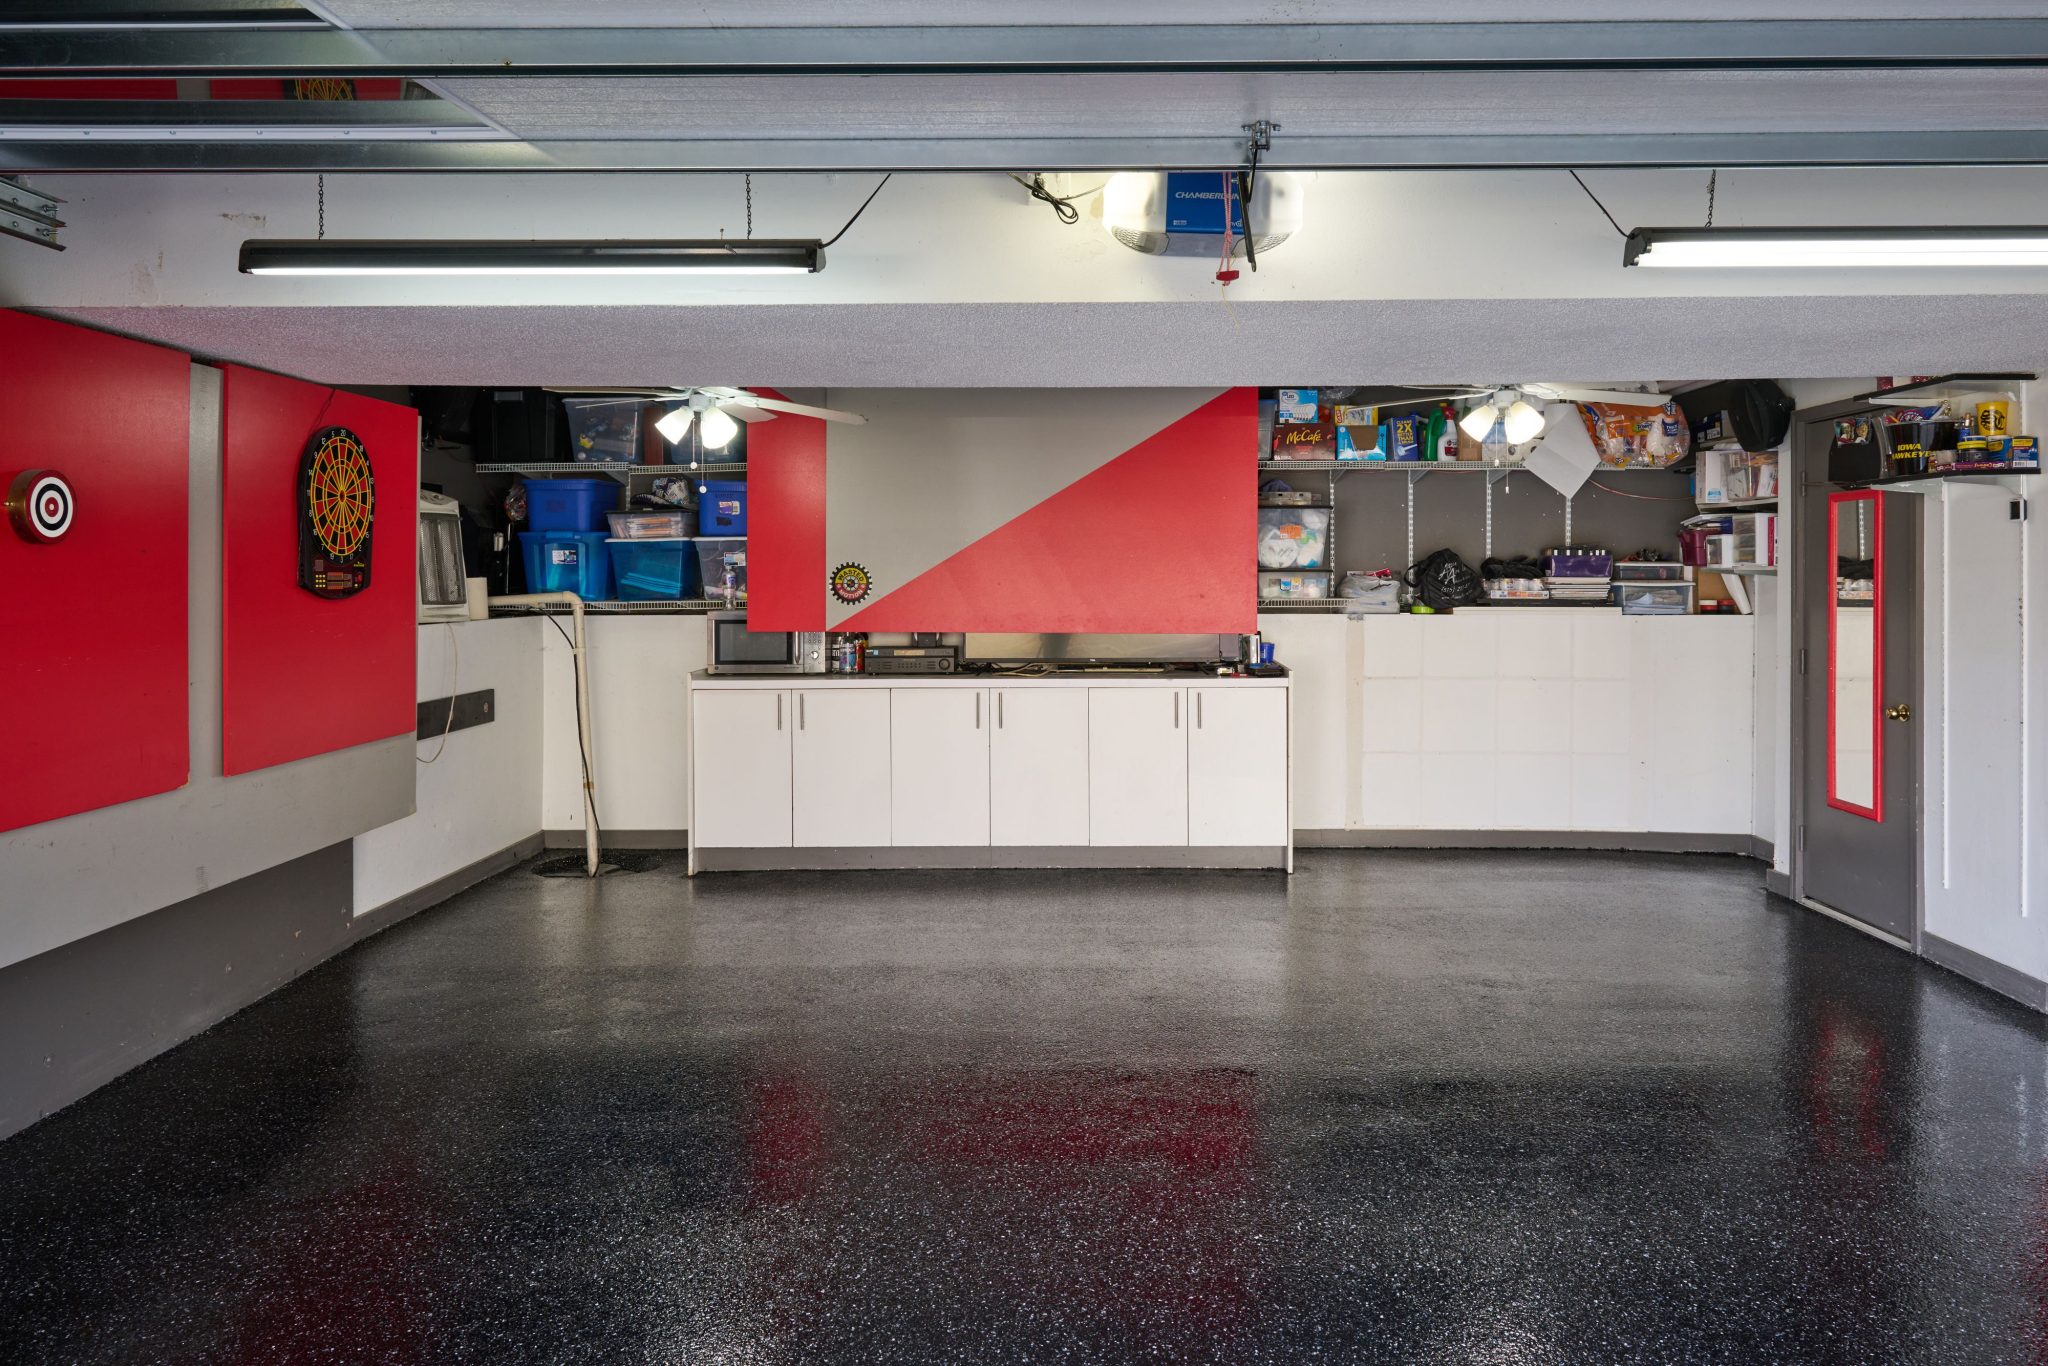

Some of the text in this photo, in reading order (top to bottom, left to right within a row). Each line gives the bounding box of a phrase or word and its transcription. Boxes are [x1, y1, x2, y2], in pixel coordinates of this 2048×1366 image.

[1175, 191, 1239, 200] CHAMBERLIN
[1396, 423, 1412, 433] 2X
[1286, 429, 1321, 445] McCafé
[1897, 443, 1921, 451] IOWA
[838, 569, 864, 581] WASTED
[839, 589, 863, 599] MOTION
